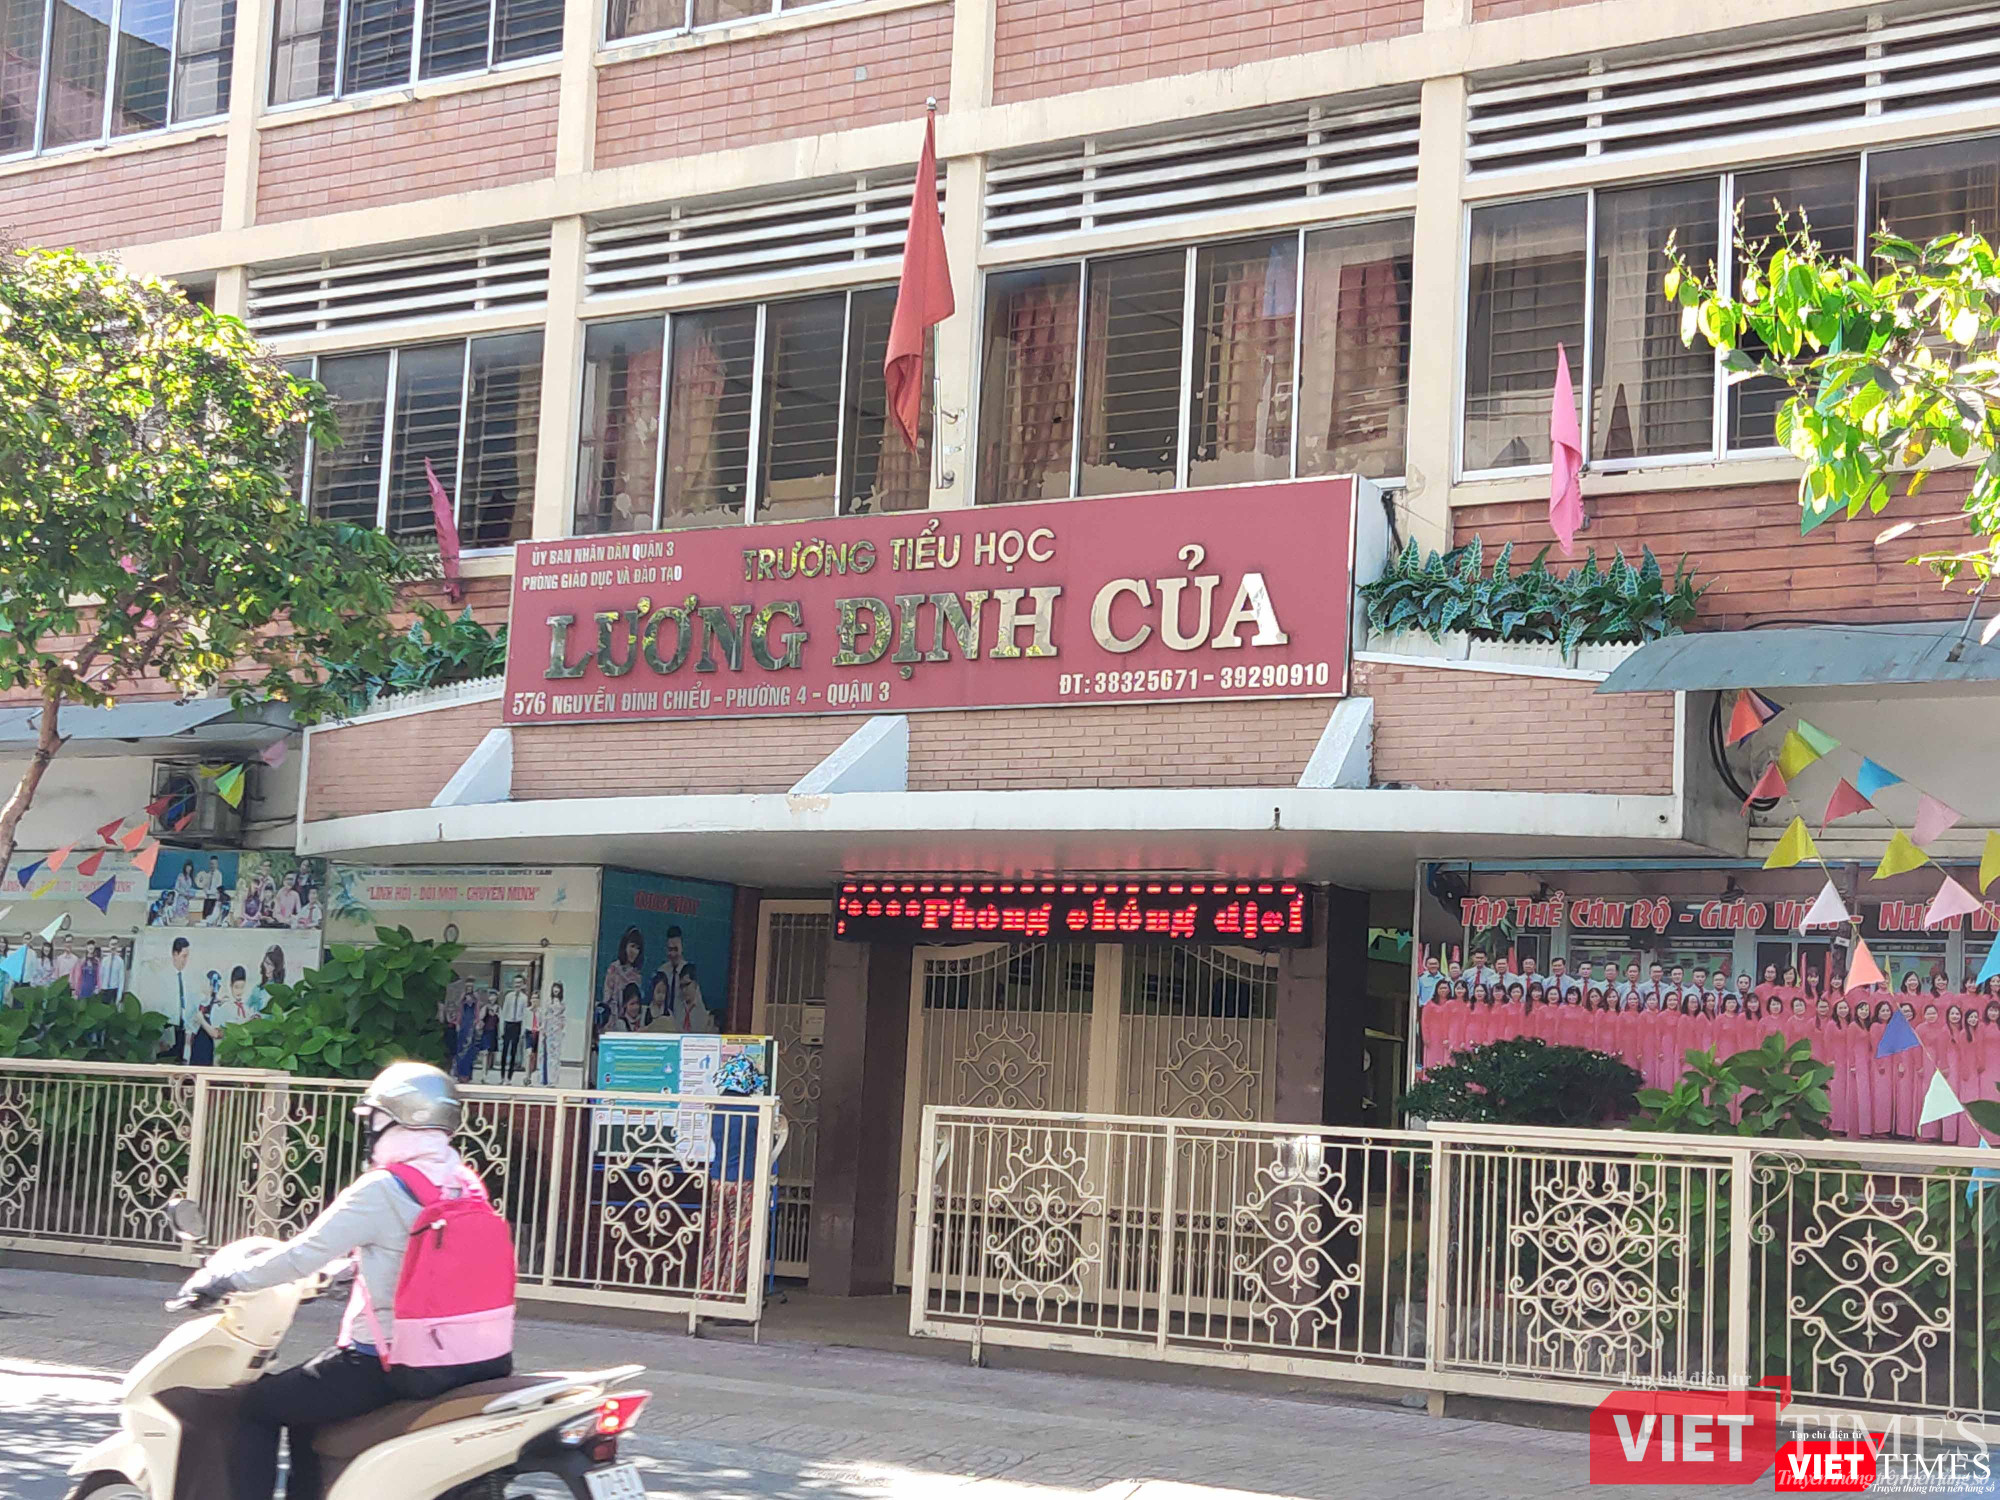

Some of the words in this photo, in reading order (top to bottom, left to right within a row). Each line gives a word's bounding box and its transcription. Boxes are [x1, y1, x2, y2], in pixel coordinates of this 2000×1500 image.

[549, 548, 572, 566] BAN
[606, 542, 631, 561] DÂN
[632, 539, 664, 562] QUẬN
[666, 541, 675, 557] 3
[742, 537, 877, 582] TRƯỜNG
[890, 518, 962, 571] TIỂU
[974, 527, 1057, 573] HỌC
[522, 571, 559, 592] PHÒNG
[590, 570, 614, 590] DỤC
[616, 565, 631, 585] VÀ
[660, 564, 683, 586] TẠO
[544, 593, 809, 681] LƯƠNG
[831, 585, 1063, 681] ĐỊNH
[1090, 543, 1290, 654] CỦA
[1220, 661, 1330, 690] 39290910
[512, 691, 547, 716] 576
[551, 685, 616, 715] NGUYỄN
[663, 680, 712, 710] CHIỂU
[725, 681, 792, 709] PHƯỜNG
[796, 685, 808, 705] 4
[827, 679, 874, 709] QUẬN
[878, 681, 891, 702] 3
[1459, 895, 1508, 933] TẬP
[1514, 889, 1566, 929] THỂ
[1569, 896, 1628, 929] CÁN
[1630, 896, 1672, 935] BỘ
[1699, 896, 1767, 930] GIÁO
